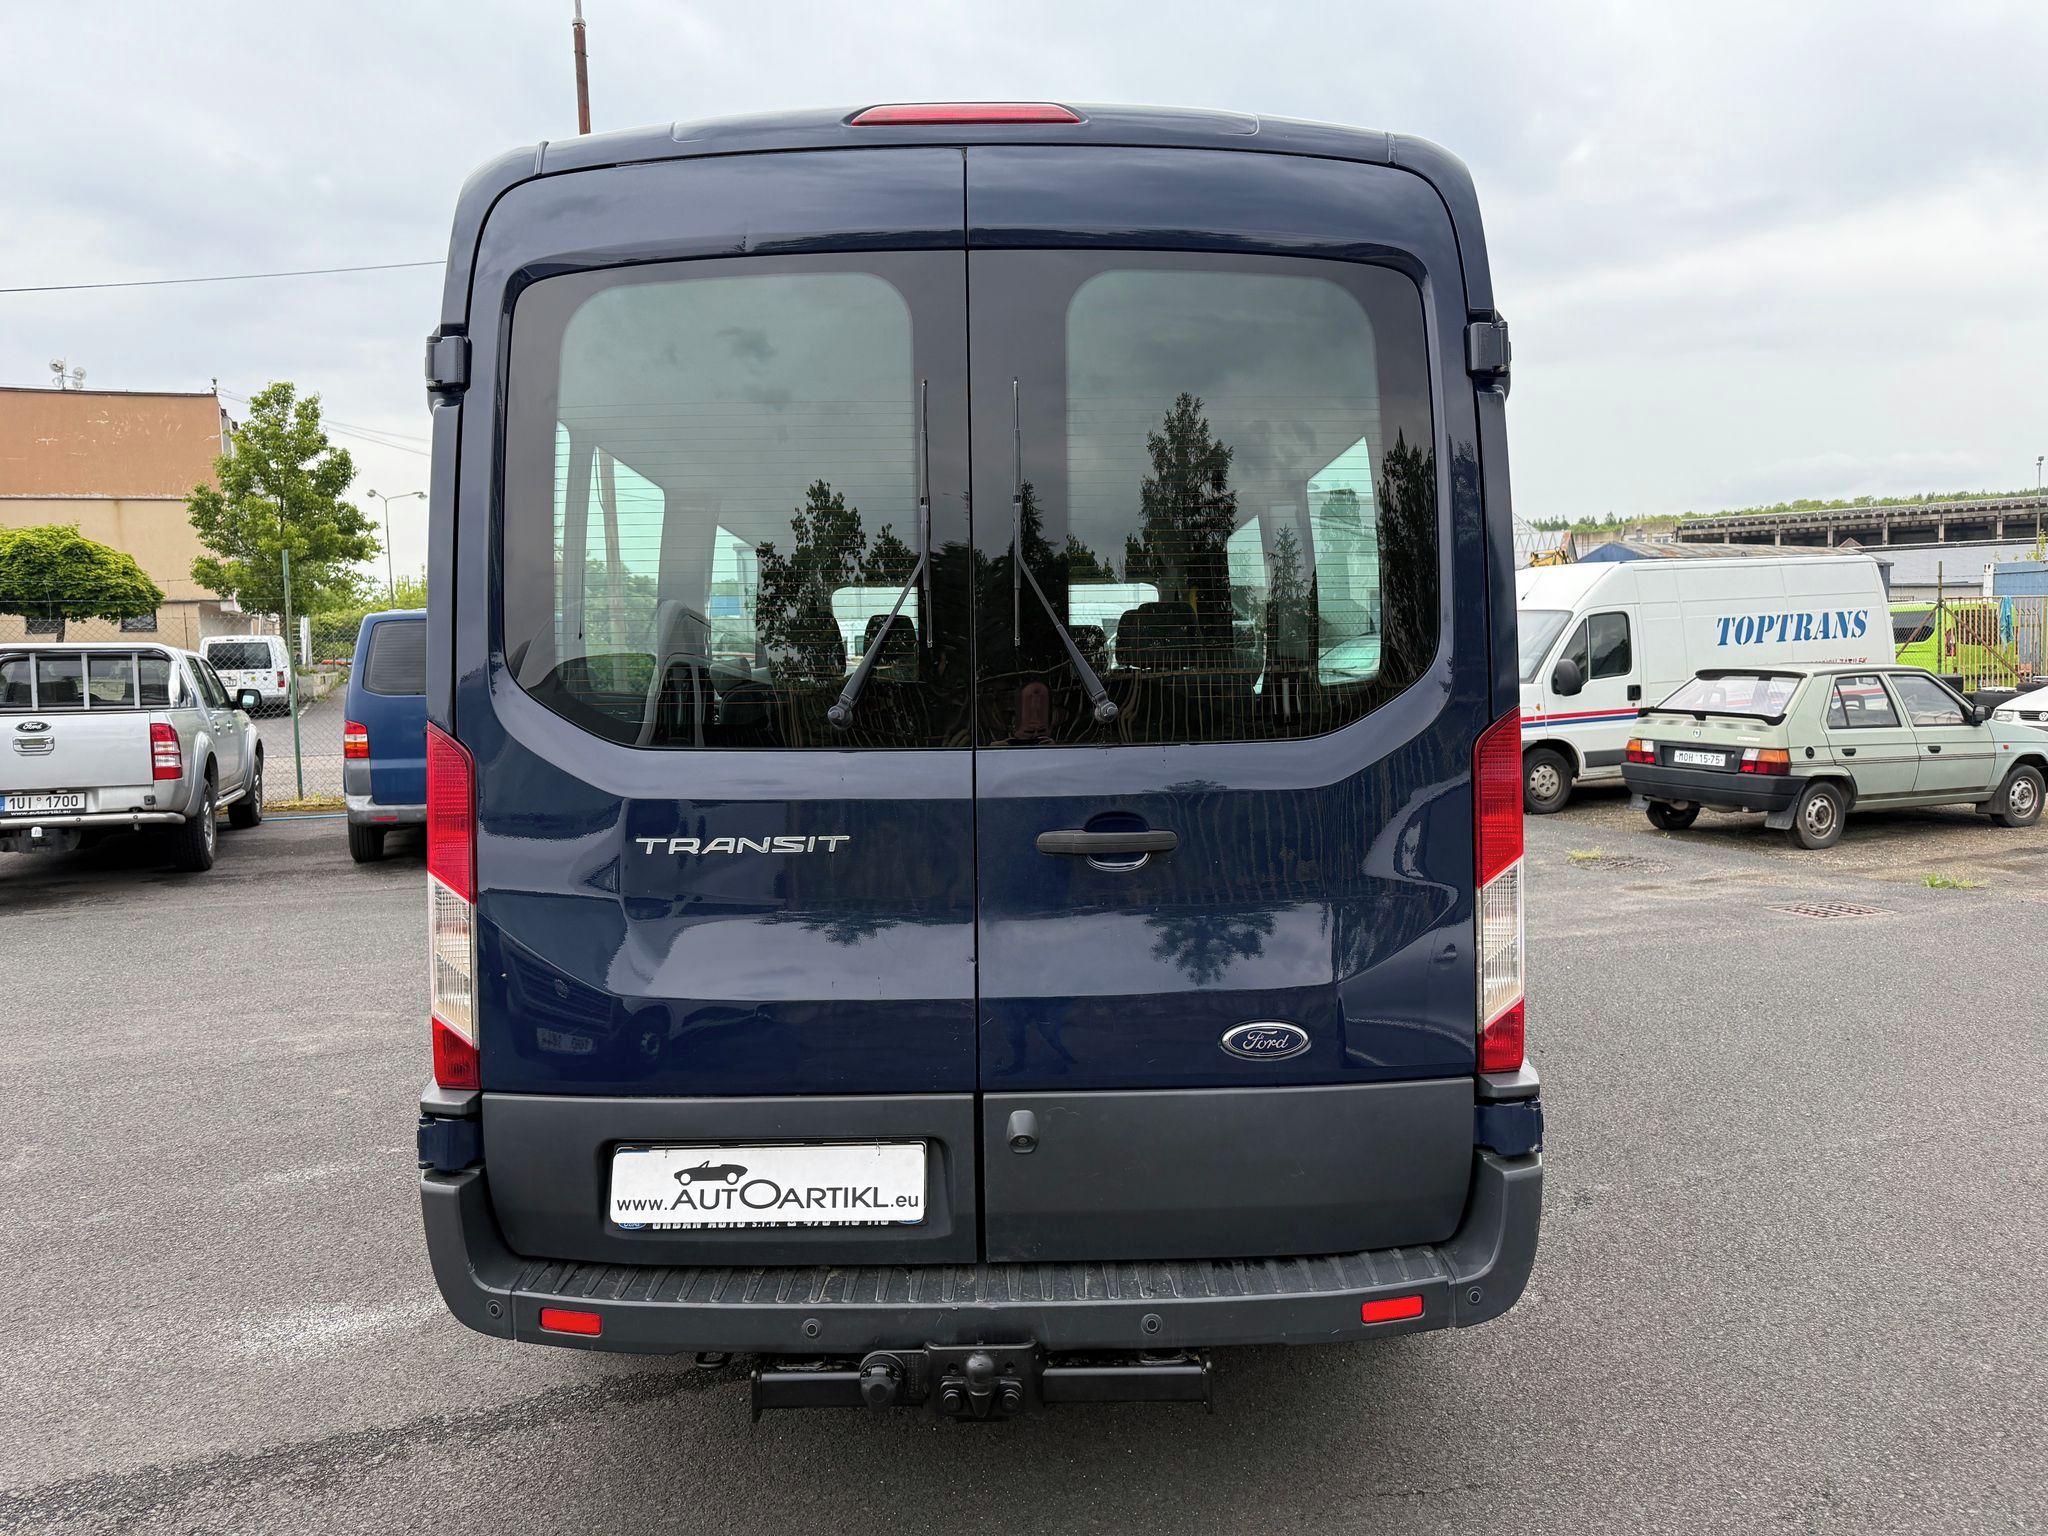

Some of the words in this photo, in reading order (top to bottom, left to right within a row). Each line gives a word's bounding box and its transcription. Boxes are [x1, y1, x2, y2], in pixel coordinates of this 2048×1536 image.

[1716, 609, 1869, 647] TOPTRANS
[22, 721, 43, 730] Ford
[1678, 752, 1694, 762] MOH
[8, 797, 32, 809] 1UI
[45, 795, 79, 808] 1700
[635, 835, 851, 855] TRANSIT
[1242, 1030, 1290, 1050] Ford
